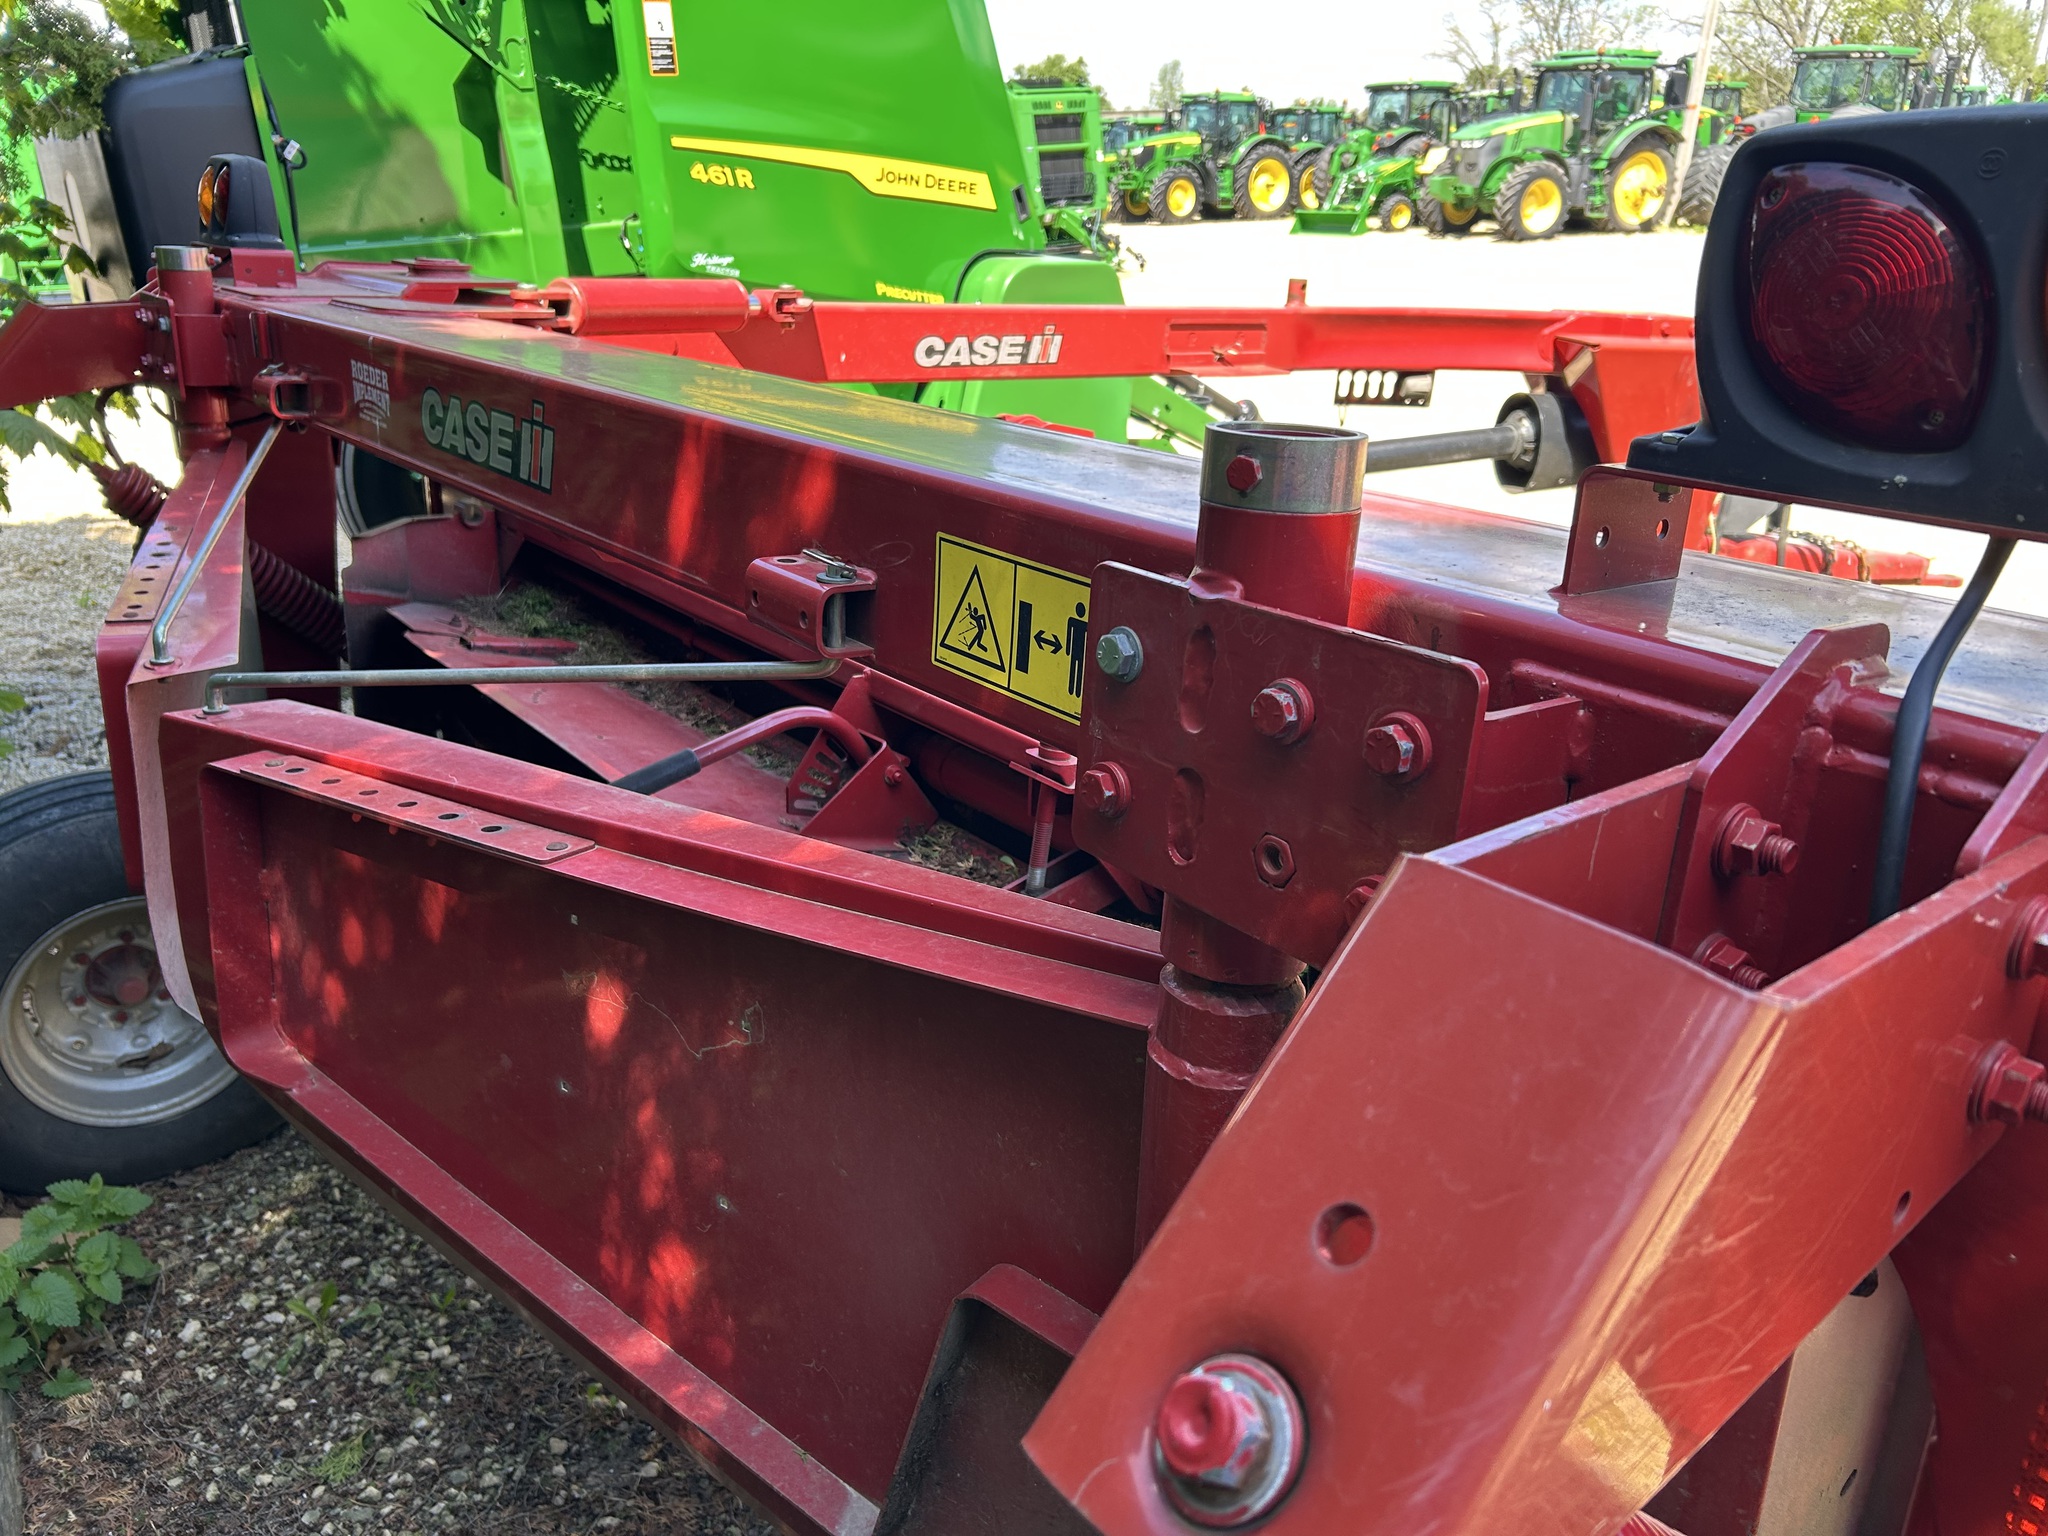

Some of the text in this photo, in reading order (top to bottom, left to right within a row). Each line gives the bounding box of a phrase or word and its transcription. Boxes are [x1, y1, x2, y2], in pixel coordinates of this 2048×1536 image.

[876, 167, 977, 195] JOHN DEERE
[914, 335, 1027, 368] CASE
[350, 359, 389, 391] ROEDER
[352, 380, 391, 417] IMPLEMENT
[421, 388, 514, 474] CASE
